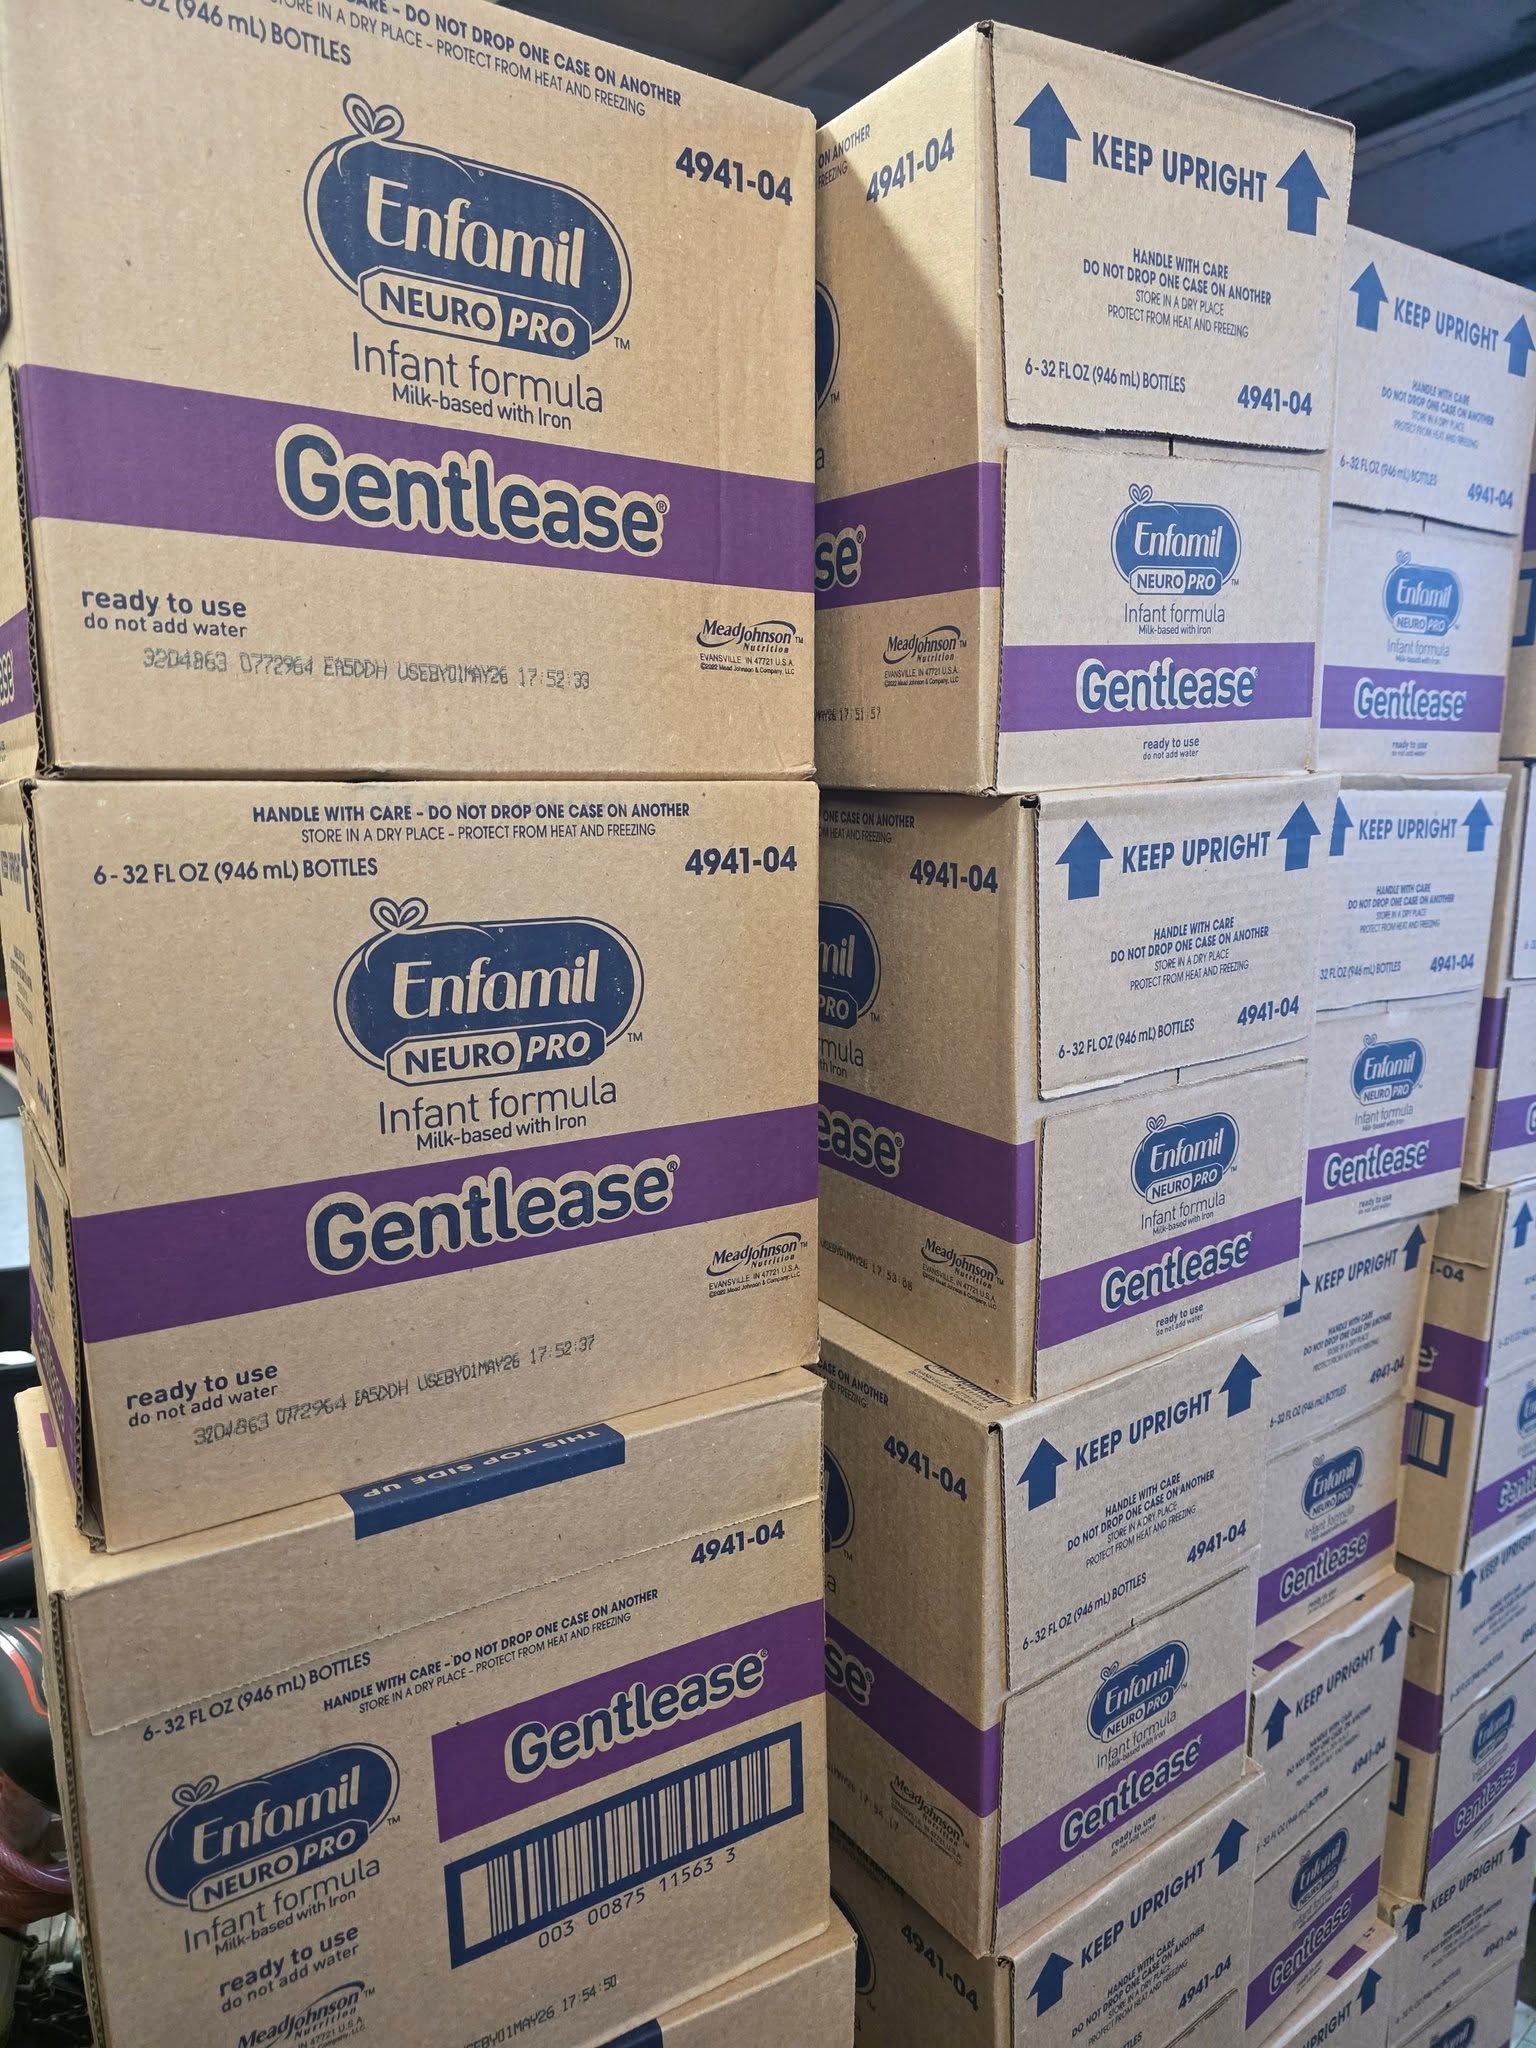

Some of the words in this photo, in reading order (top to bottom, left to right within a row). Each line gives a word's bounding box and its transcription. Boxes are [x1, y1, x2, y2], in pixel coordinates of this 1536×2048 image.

[676, 148, 791, 204] 4941-04
[866, 130, 953, 203] 4941-04
[1092, 133, 1152, 174] KEEP
[1162, 151, 1266, 201] UPRIGHT
[366, 176, 586, 288] Enfamil
[1083, 258, 1100, 275] DO
[1102, 262, 1124, 279] NOT
[1127, 266, 1156, 284] DROP
[1158, 272, 1180, 290] ONE
[1182, 276, 1208, 294] CASE
[1210, 281, 1225, 297] ON
[1228, 285, 1271, 304] ANOTHER
[1133, 248, 1172, 269] HANDLE
[1175, 256, 1200, 274] WITH
[1202, 261, 1228, 279] CARE
[379, 282, 497, 334] NEURO
[506, 308, 575, 350] PRO
[1394, 298, 1430, 328] KEEP
[1435, 312, 1498, 350] UPRIGHT
[353, 333, 458, 387] Infant
[470, 355, 602, 412] formula
[392, 383, 493, 417] Milk-based
[497, 402, 534, 424] with
[538, 407, 571, 430] Iron
[1237, 385, 1311, 415] 4941-04
[1135, 522, 1223, 558] Enfamil
[1137, 573, 1183, 589] NEURO
[1186, 572, 1216, 590] PRO
[1396, 578, 1452, 609] Enfamil
[82, 590, 158, 615] ready
[166, 592, 193, 614] to
[201, 599, 246, 618] use
[1124, 602, 1166, 623] Infant
[1170, 603, 1225, 623] formula
[1396, 616, 1425, 632] NEURO
[1427, 617, 1446, 632] PRO
[84, 613, 108, 629] do
[115, 616, 147, 632] not
[152, 618, 187, 634] add
[193, 622, 247, 637] water
[742, 643, 789, 654] Nutrition
[1142, 737, 1169, 750] ready
[1171, 737, 1181, 748] to
[1183, 737, 1200, 747] use
[252, 806, 319, 822] HANDLE
[324, 805, 364, 821] WITH
[370, 805, 411, 821] CARE
[428, 804, 452, 820] DO
[456, 804, 486, 820] NOT
[490, 804, 531, 819] DROP
[535, 803, 564, 819] ONE
[568, 803, 603, 818] CASE
[607, 803, 627, 817] ON
[631, 802, 689, 817] ANOTHER
[1358, 818, 1393, 840] KEEP
[1397, 818, 1456, 839] UPRIGHT
[214, 861, 258, 883] (946
[262, 860, 299, 881] mL)
[303, 857, 378, 878] BOTTLES
[685, 846, 796, 875] 4941-04
[1122, 842, 1174, 872] KEEP
[1182, 831, 1270, 865] UPRIGHT
[910, 859, 997, 892] 4941-04
[1153, 924, 1187, 940] HANDLE
[1189, 920, 1210, 934] WITH
[1212, 916, 1234, 930] CARE
[1430, 954, 1474, 971] 4941-04
[393, 949, 600, 1018] Enfamil
[1237, 996, 1298, 1024] 4941-04
[405, 1043, 515, 1075] NEURO
[525, 1033, 592, 1062] PRO
[1364, 1052, 1415, 1084] Enfamil
[379, 1094, 478, 1133] Infant
[490, 1078, 616, 1118] formula
[1363, 1086, 1390, 1102] NEURO
[1392, 1083, 1410, 1098] PRO
[1354, 1110, 1379, 1125] Infant
[1380, 1104, 1413, 1120] formula
[1151, 1128, 1224, 1172] Enfamil
[1152, 1179, 1190, 1199] NEURO
[1193, 1169, 1218, 1190] PRO
[1141, 1206, 1176, 1229] Infant
[1179, 1193, 1225, 1217] formula
[1314, 1267, 1344, 1293] KEEP
[1348, 1248, 1398, 1281] UPRIGHT
[126, 1380, 197, 1409] ready
[203, 1375, 228, 1392] to
[236, 1365, 277, 1386] use
[542, 1431, 600, 1448] THIS
[1075, 1429, 1122, 1469] KEEP
[1129, 1390, 1211, 1443] UPRIGHT
[414, 1464, 473, 1485] SIDE
[483, 1448, 536, 1466] TOP
[884, 1436, 966, 1500] 4941-04
[363, 1484, 402, 1498] UP
[691, 1520, 784, 1563] 4941-04
[1186, 1521, 1246, 1562] 4941-04
[237, 1684, 273, 1710] (946
[276, 1673, 306, 1696] mL)
[308, 1651, 370, 1684] BOTTLES
[1104, 1654, 1175, 1714] Enfamil
[1297, 1683, 1323, 1708] KEEP
[1326, 1648, 1373, 1691] UPRIGHT
[1106, 1709, 1143, 1738] NEURO
[1146, 1692, 1168, 1714] PRO
[192, 1765, 362, 1866] Enfamil
[202, 1854, 296, 1905] NEURO
[304, 1825, 356, 1866] PRO
[1430, 1884, 1456, 1912] KEEP
[1458, 1851, 1503, 1891] UPRIGHT
[184, 1902, 265, 1952] Infant
[274, 1859, 380, 1915] formula
[538, 1919, 574, 1948] 003
[587, 1886, 645, 1925] 00875
[659, 1856, 713, 1891] 11563
[725, 1846, 736, 1863] 3
[1081, 1920, 1124, 1967] KEEP
[1130, 1860, 1203, 1928] UPRIGHT
[219, 1957, 284, 1996] ready
[290, 1946, 313, 1971] to
[319, 1926, 358, 1954] use
[562, 1974, 618, 2013] 17:54:50
[1178, 1956, 1231, 2008] 4941-04
